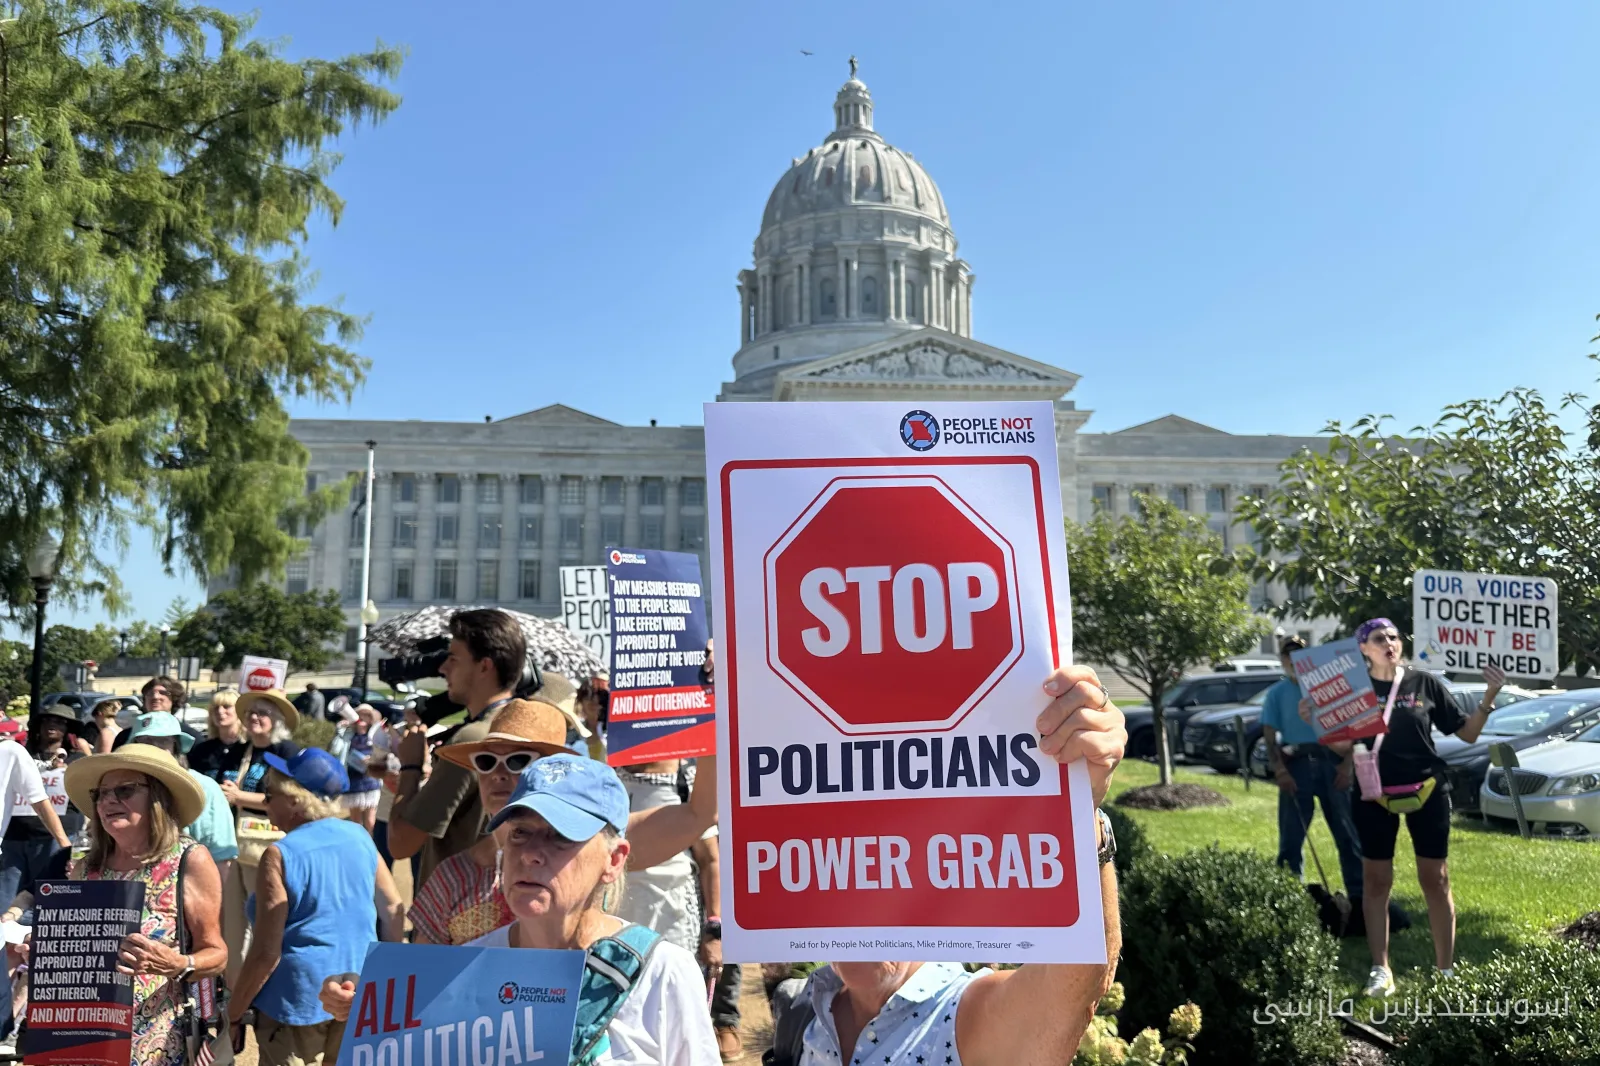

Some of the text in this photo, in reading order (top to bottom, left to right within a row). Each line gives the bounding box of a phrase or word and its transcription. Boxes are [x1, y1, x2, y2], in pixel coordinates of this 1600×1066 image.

[943, 417, 1033, 431] PEOPLE NOT
[943, 431, 1036, 444] POLITICIANS
[562, 568, 598, 597] LET
[631, 580, 668, 596] MEASURE
[668, 582, 701, 598] REFERRED
[1424, 575, 1546, 600] OUR VOICES
[614, 598, 692, 614] TO THE PEOPLE SHALL
[800, 561, 1000, 658] STOP
[1420, 597, 1551, 629] TOGETHER
[615, 616, 686, 632] TAKE EFFECT WHEN
[616, 635, 658, 650] APPROVED
[659, 634, 670, 649] BY
[670, 634, 677, 649] A
[1437, 626, 1536, 651] WON'T BE
[615, 651, 706, 669] MAJORITY OF THE VOTES
[1295, 656, 1316, 674] ALL
[1445, 649, 1541, 675] SILENCED
[615, 670, 674, 688] CAST THEREON,
[1301, 653, 1357, 689] POLITICAL
[1311, 677, 1351, 707] POWER
[612, 696, 633, 715] AND
[634, 695, 654, 713] NOT
[1320, 711, 1338, 730] THE
[1336, 697, 1370, 723] PEOPLE
[747, 833, 1064, 893] POWER GRAB
[59, 909, 102, 921] MEASURE
[104, 908, 140, 924] REFERRED
[37, 924, 127, 938] TO THE PEOPLE SHALL
[36, 939, 118, 953] TAKE EFFECT WHEN
[789, 941, 806, 949] Paid
[808, 940, 819, 949] for
[820, 940, 830, 950] by
[831, 940, 857, 950] People
[859, 940, 873, 948] Not
[875, 939, 915, 949] Politicians,
[917, 940, 936, 948] Mike
[937, 940, 975, 950] Pridmore,
[976, 940, 1011, 949] Treasurer
[34, 955, 105, 969] APPROVED BY A
[34, 971, 81, 985] MAJORITY
[82, 971, 95, 984] OF
[95, 971, 110, 984] THE
[33, 987, 100, 1001] CAST THEREON,
[518, 994, 566, 1004] POLITICIANS
[520, 986, 567, 996] PEOPLE NOT
[354, 974, 422, 1038] ALL
[30, 1008, 53, 1023] AND
[55, 1008, 76, 1022] NOT
